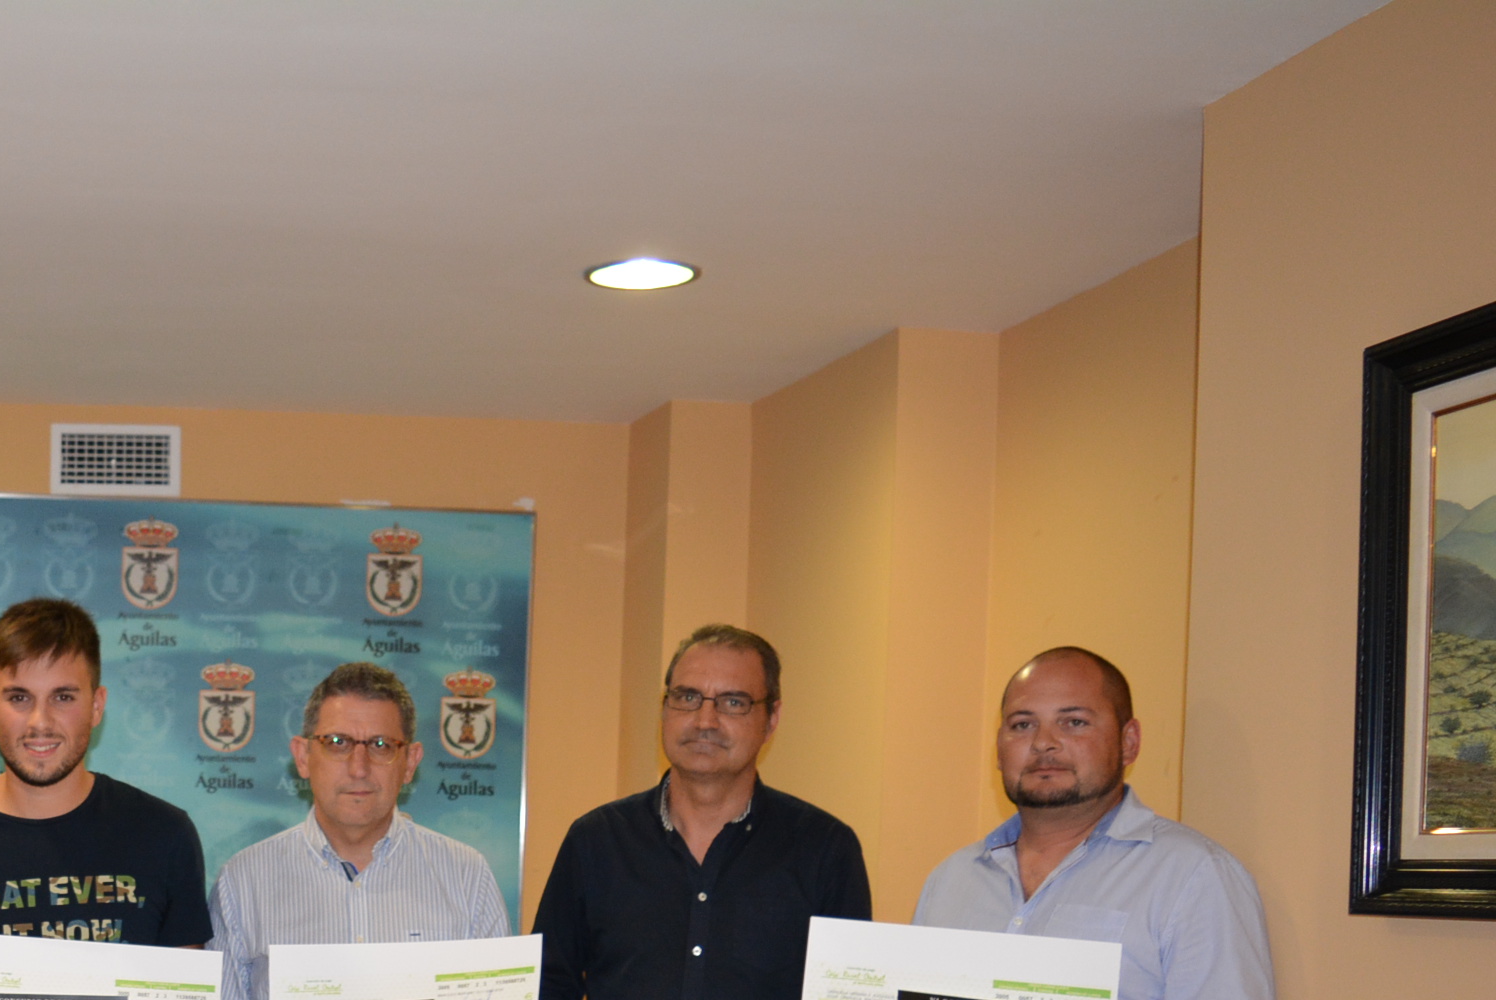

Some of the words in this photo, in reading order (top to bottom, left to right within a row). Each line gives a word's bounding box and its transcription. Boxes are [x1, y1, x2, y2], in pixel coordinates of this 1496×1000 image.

[118, 629, 178, 652] Águilas
[363, 635, 422, 658] Águilas
[442, 640, 500, 662] Águilas
[195, 772, 254, 794] Águilas
[436, 778, 496, 801] Águilas
[49, 874, 146, 909] EVER,
